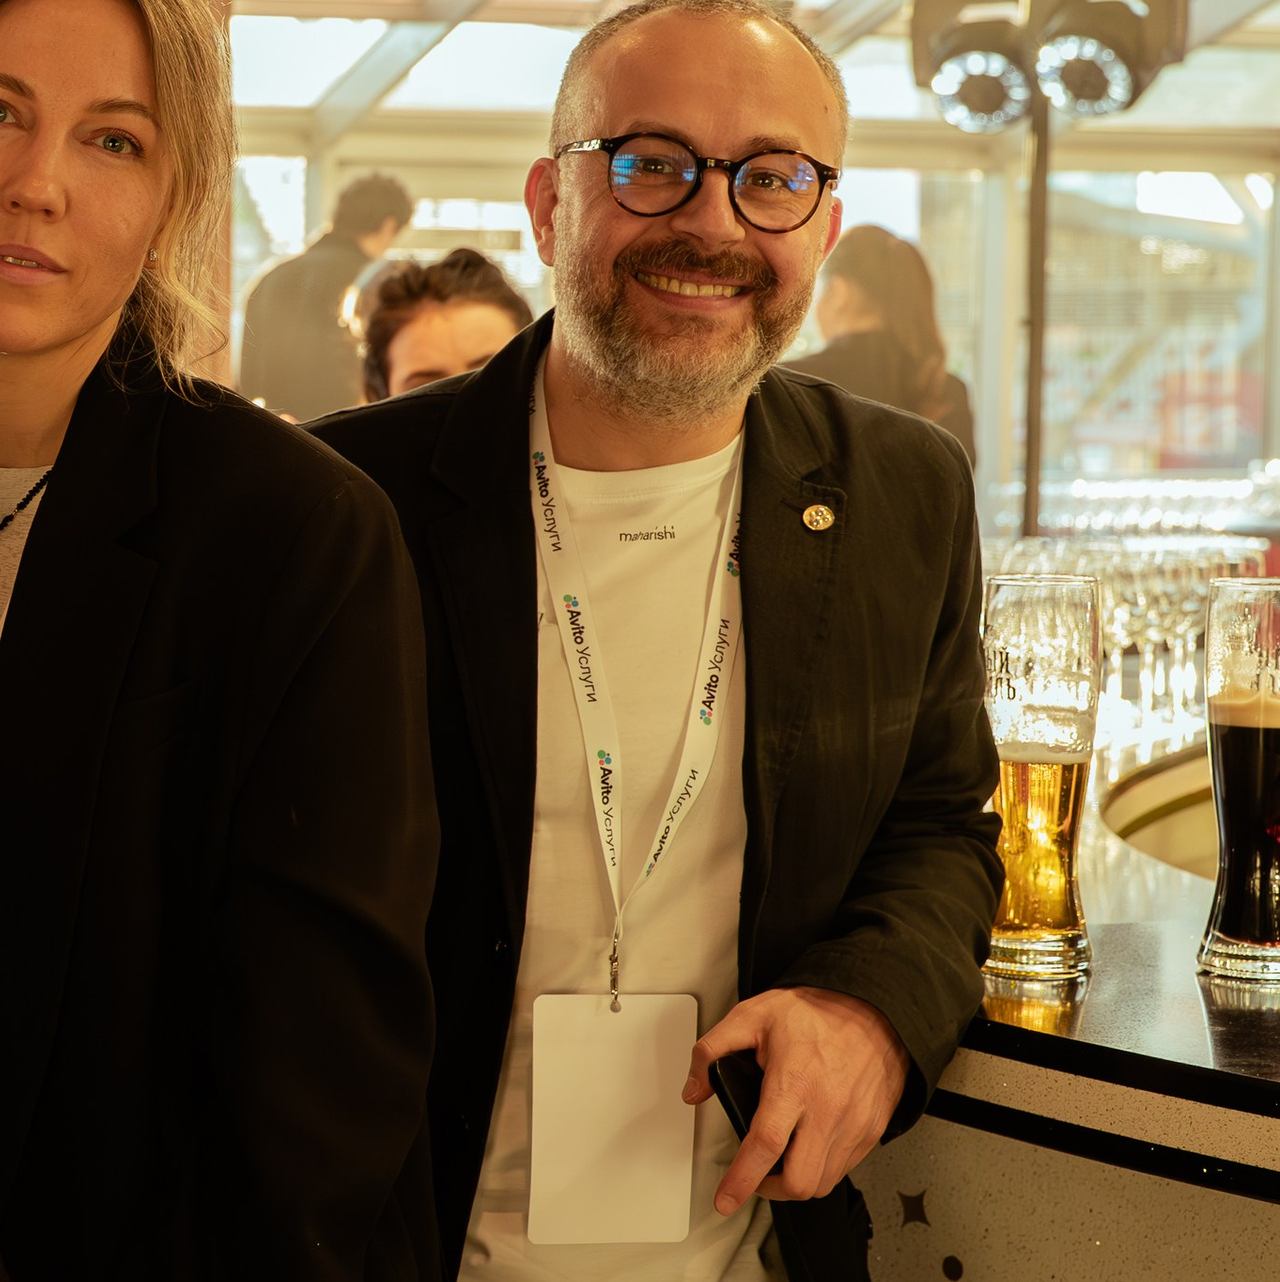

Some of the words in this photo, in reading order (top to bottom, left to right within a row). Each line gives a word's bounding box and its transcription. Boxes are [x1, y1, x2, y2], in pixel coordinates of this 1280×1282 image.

[534, 464, 550, 498] Avito
[542, 497, 562, 552] Услуги
[567, 609, 585, 645] Avito
[576, 646, 597, 703] Услуги
[708, 618, 731, 672] Услуги
[701, 673, 720, 711] Avito
[599, 766, 613, 806] Avito
[652, 824, 671, 864] Avito
[666, 768, 699, 823] Услуги
[603, 807, 617, 867] Услуги
